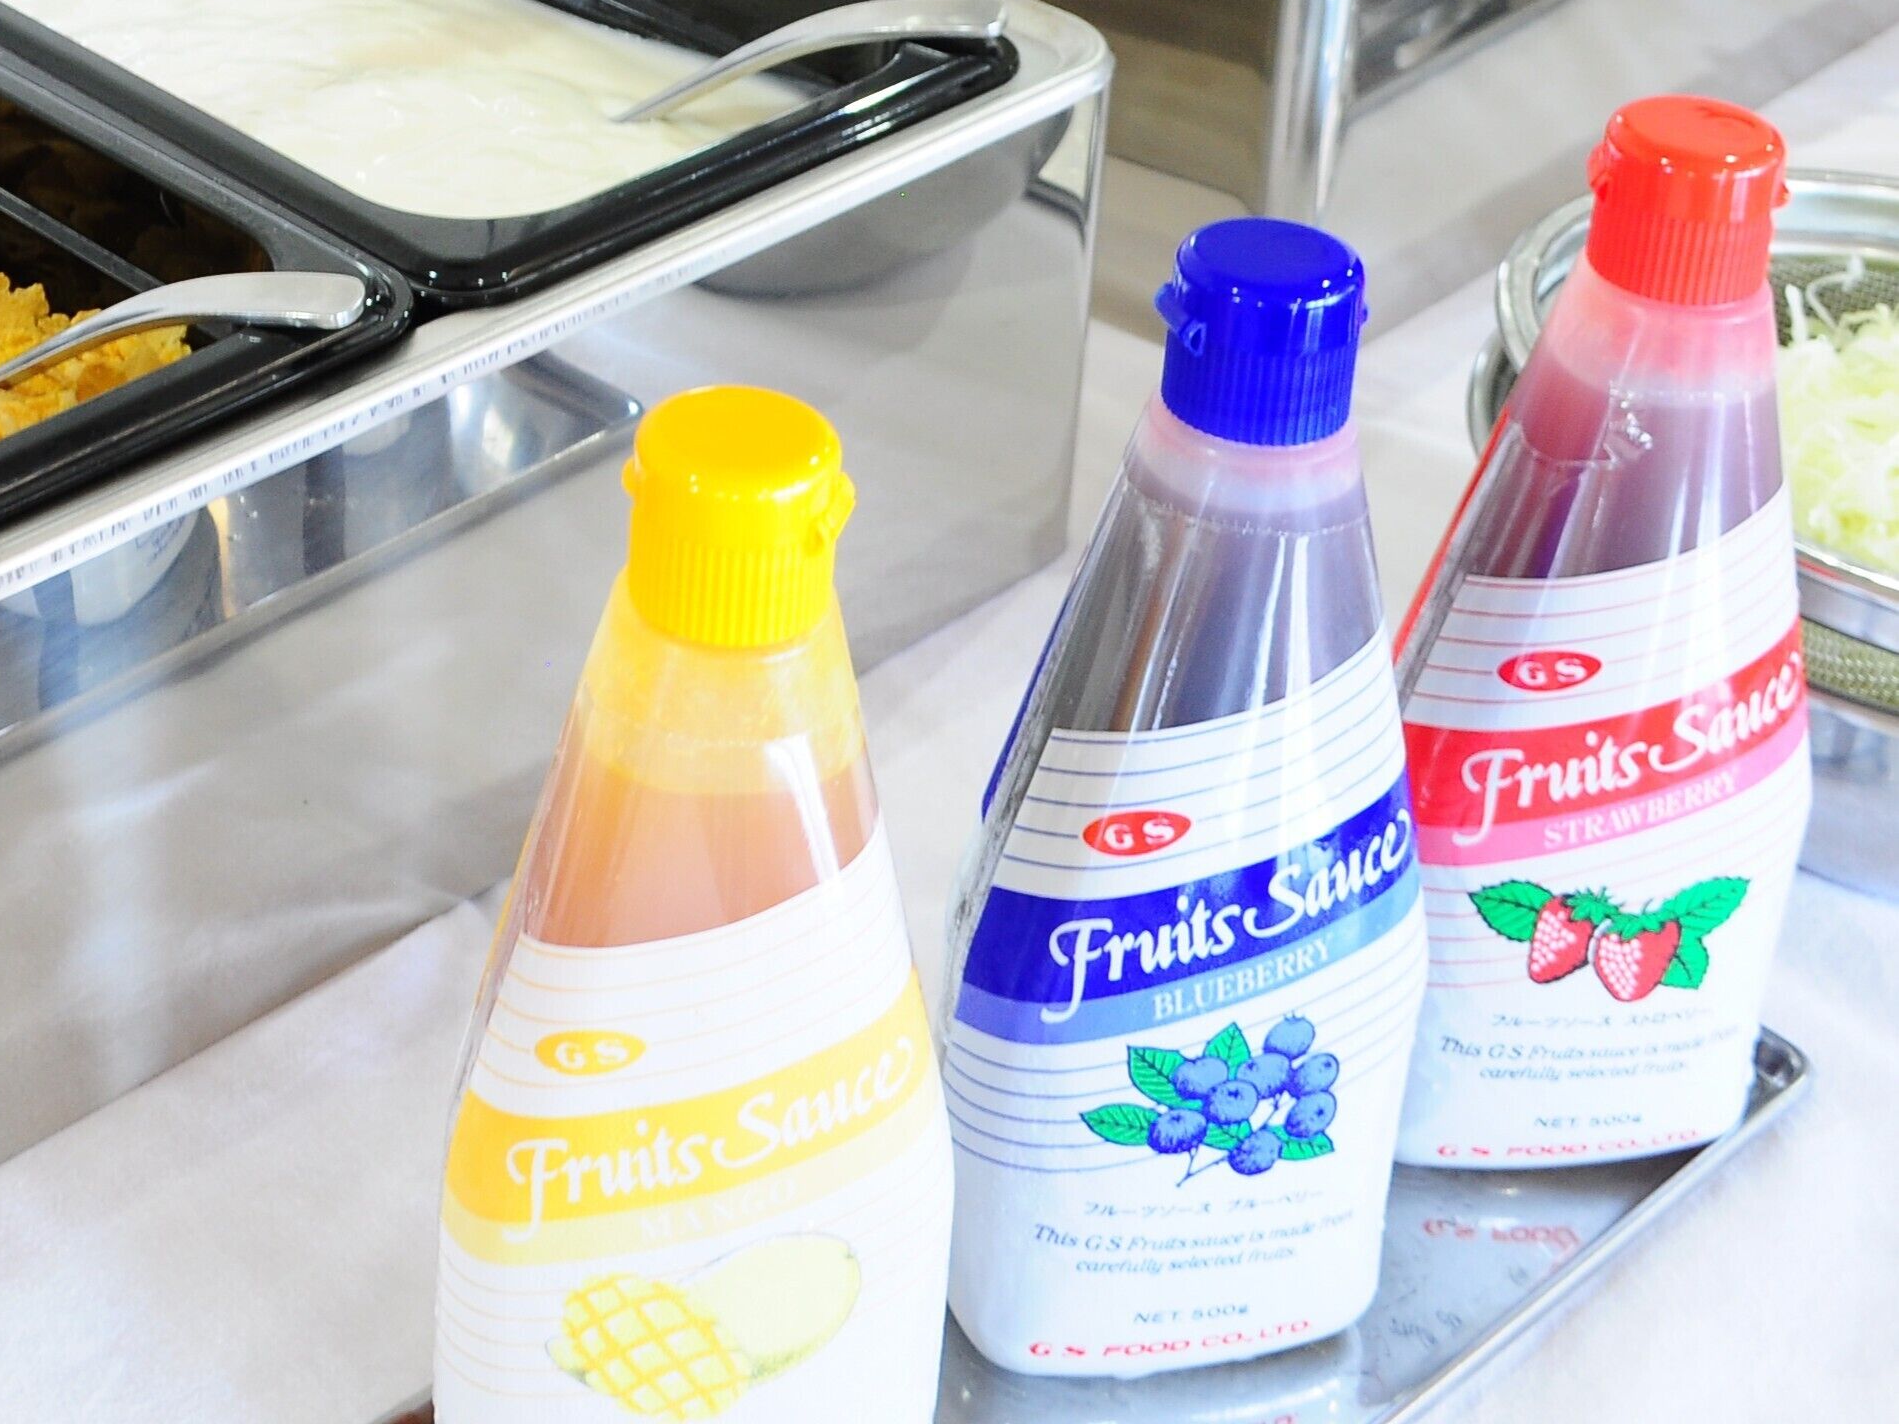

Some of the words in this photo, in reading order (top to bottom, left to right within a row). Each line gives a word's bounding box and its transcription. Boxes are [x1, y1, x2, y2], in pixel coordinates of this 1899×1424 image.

[1452, 730, 1647, 847] Fruits
[1648, 651, 1802, 774] Sauce
[1543, 768, 1740, 851] STRAWBERRY
[1040, 895, 1241, 1025] Fruits
[1242, 807, 1411, 939] Sauce
[1152, 934, 1333, 1021] BLUEBERRY
[1439, 1034, 1482, 1057] This
[1528, 1043, 1585, 1061] Fruits
[1479, 1064, 1561, 1082] carefully
[503, 1119, 708, 1244] Fruits
[710, 1035, 914, 1169] Sauce
[1505, 1142, 1588, 1157] FOOD
[1033, 1223, 1079, 1249] This
[1127, 1235, 1187, 1252] Fruits
[1188, 1232, 1245, 1248] sauce
[1074, 1256, 1163, 1275] carefully
[1167, 1251, 1244, 1271] selected
[1102, 1339, 1191, 1357] FOOD
